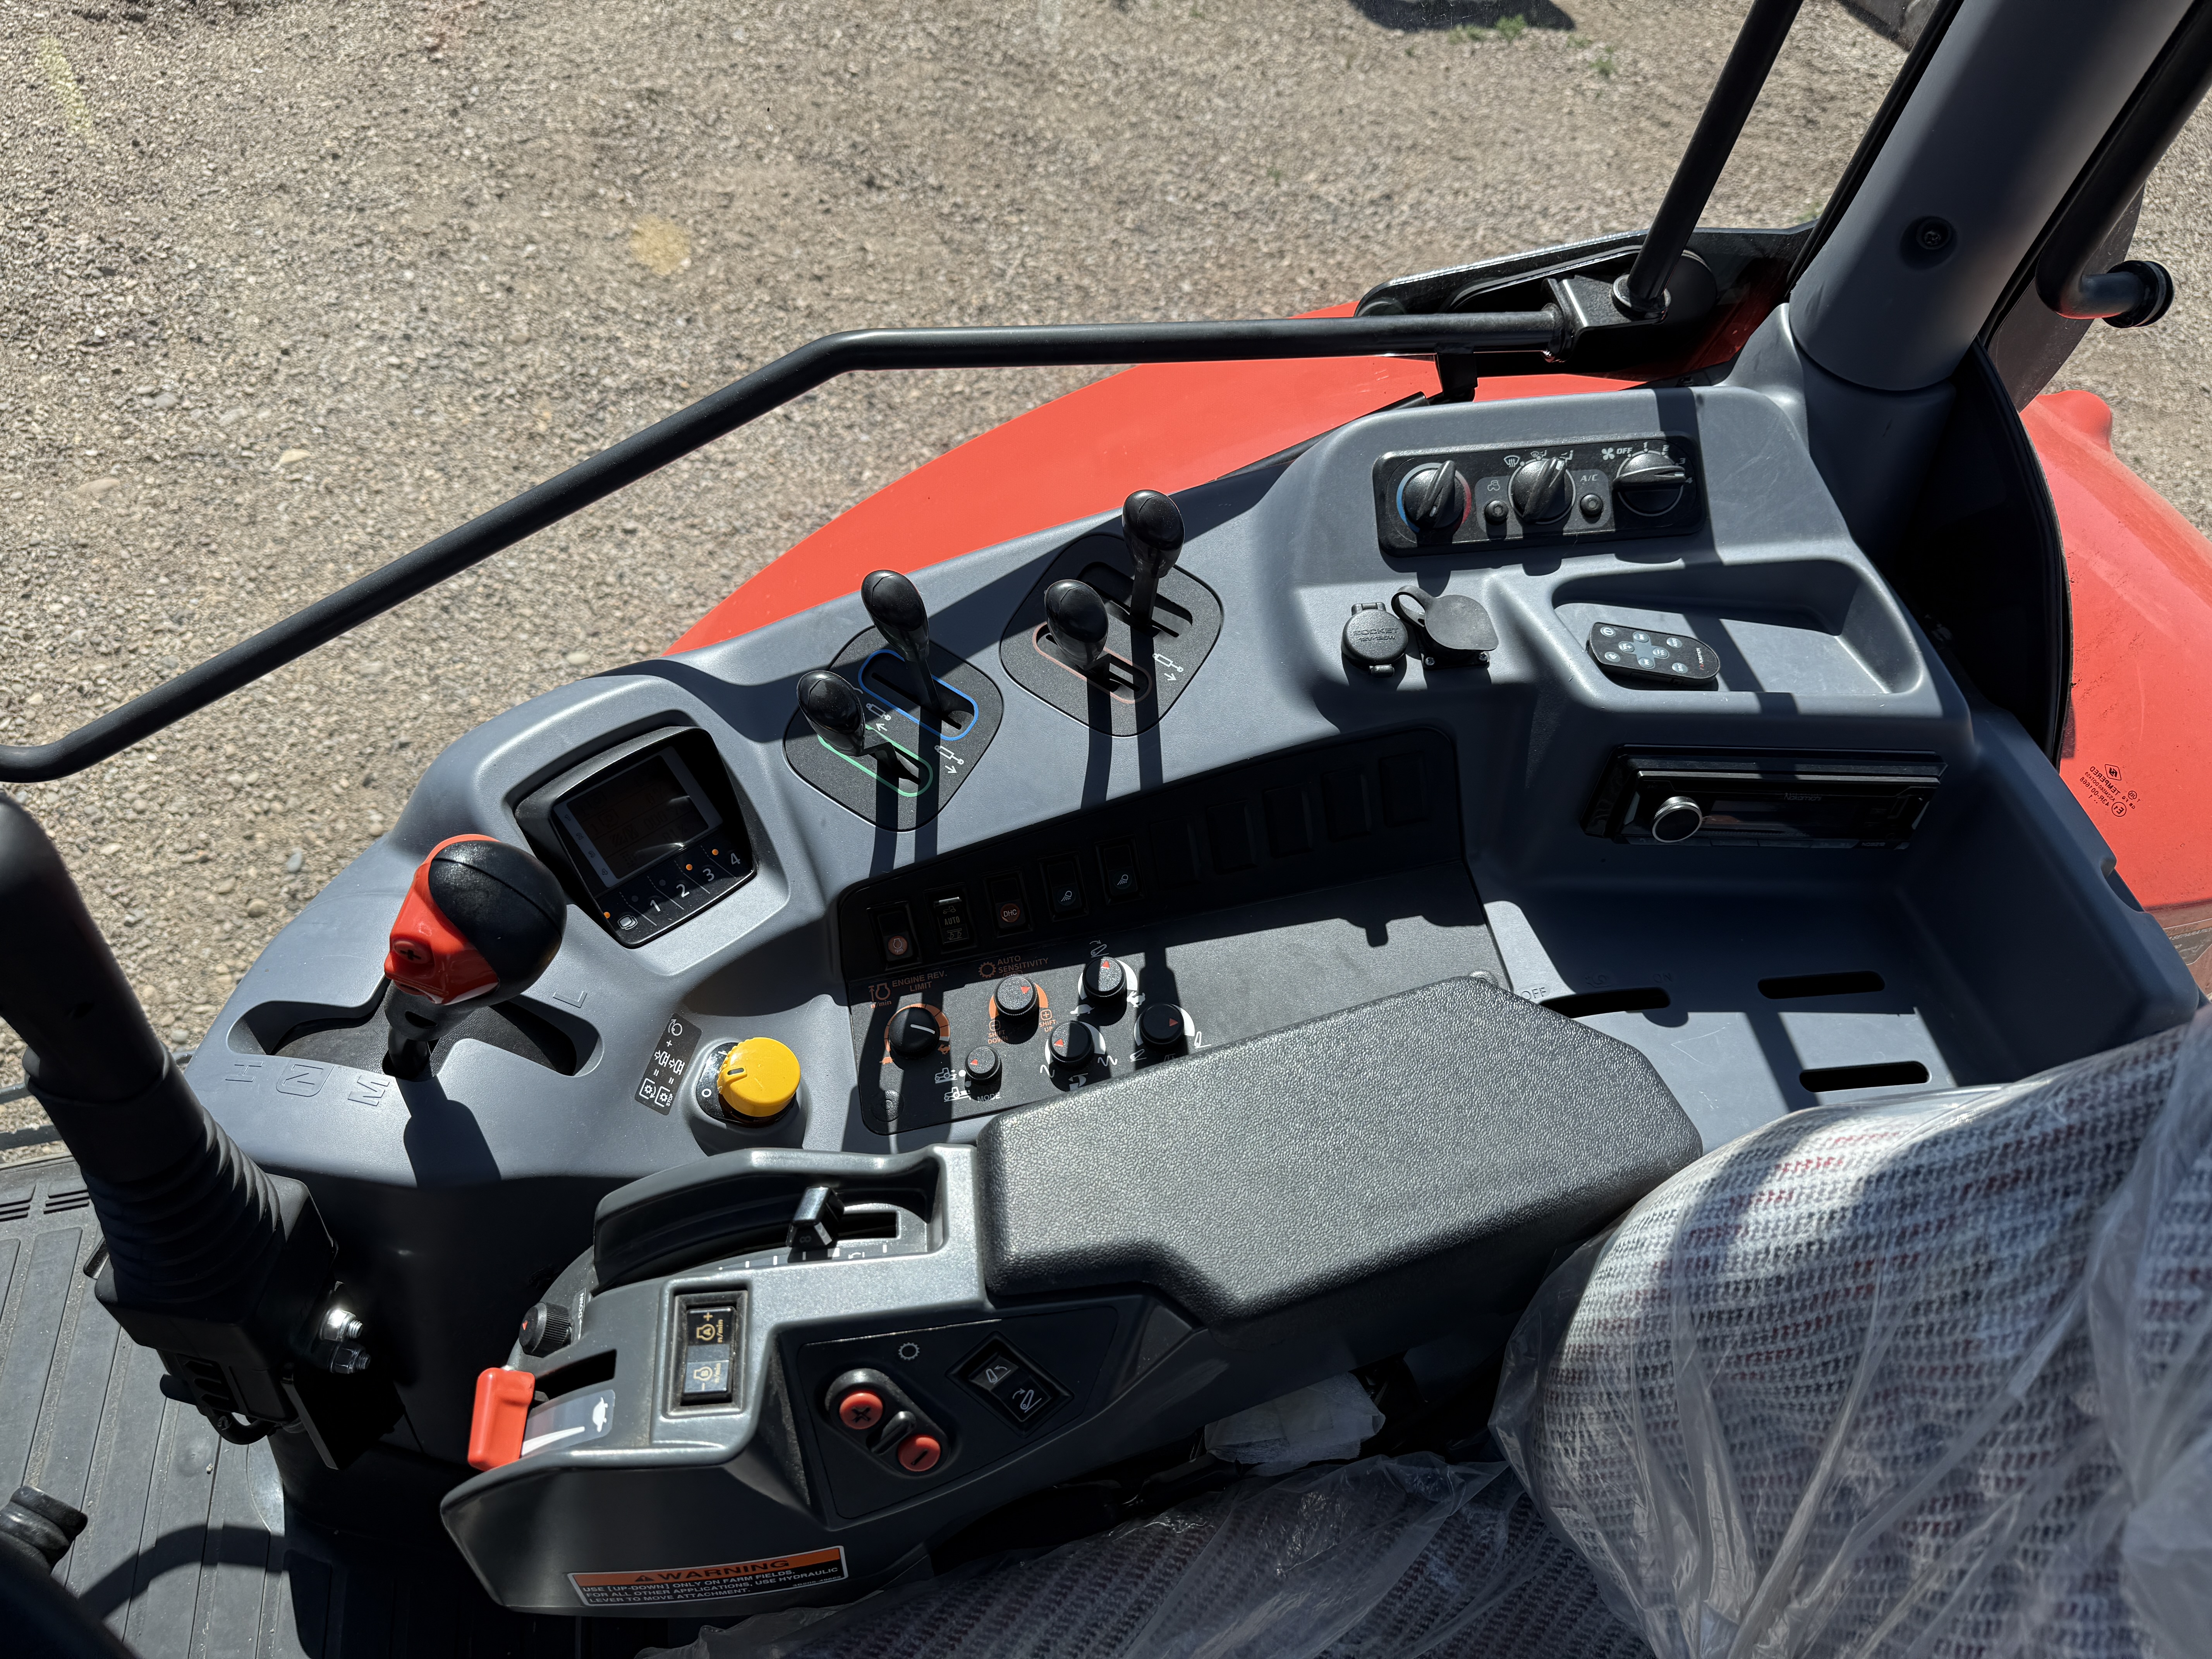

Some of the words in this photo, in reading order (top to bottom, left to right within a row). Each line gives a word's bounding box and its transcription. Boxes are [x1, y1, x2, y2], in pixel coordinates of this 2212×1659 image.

[1580, 474, 1598, 482] A/C
[730, 853, 740, 865] 4
[702, 868, 714, 881] 3
[676, 884, 690, 898] 2
[650, 900, 661, 912] 1
[1003, 909, 1017, 917] DHC
[945, 916, 960, 925] AUTO
[997, 955, 1022, 966] AUTO
[998, 957, 1049, 974] SENSITIVITY
[892, 975, 926, 988] ENGINE
[927, 970, 948, 981] REV.
[1652, 972, 1673, 983] ON
[910, 981, 932, 992] LIMIT
[1521, 987, 1546, 1000] OFF
[1039, 1020, 1056, 1028] SHIFT
[988, 1036, 1008, 1044] DOWN
[347, 1075, 390, 1107] M
[977, 1092, 1001, 1102] MODE
[658, 1560, 789, 1580] WARNING
[778, 1567, 838, 1582] HYDRAULIC
[607, 1583, 670, 1592] [UP-DOWN]
[723, 1576, 753, 1584] FARM
[755, 1570, 795, 1580] FIELDS.
[677, 1588, 751, 1599] ATTACHMENT.
